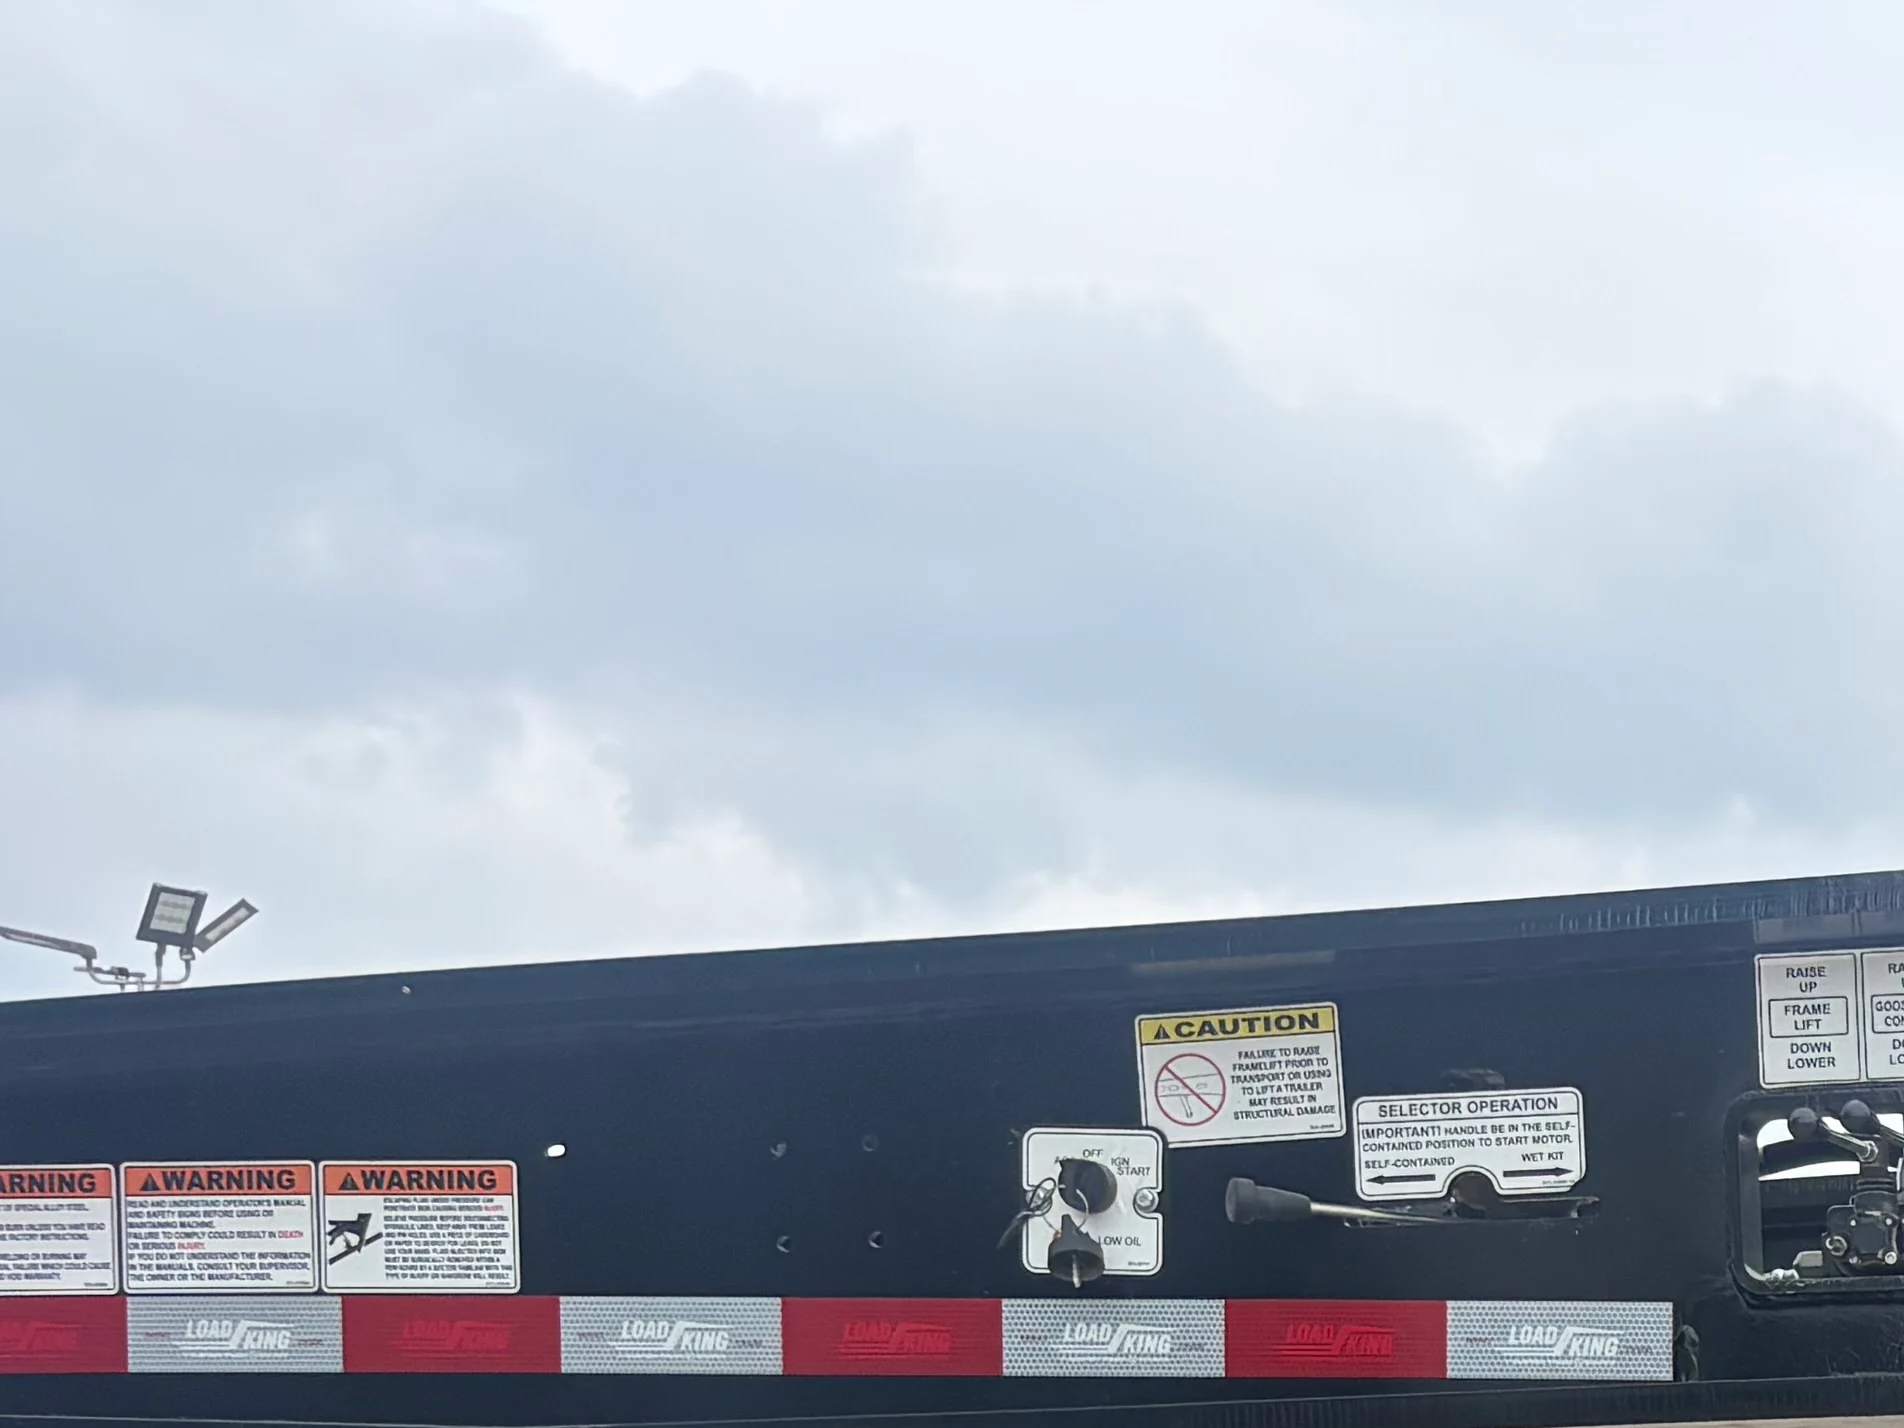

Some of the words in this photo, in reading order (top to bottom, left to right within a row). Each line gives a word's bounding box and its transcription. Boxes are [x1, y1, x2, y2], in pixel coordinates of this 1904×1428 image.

[1786, 967, 1827, 978] RAISE
[1800, 982, 1817, 993] UP
[1784, 1003, 1831, 1016] FRAME
[1174, 1013, 1319, 1037] CAUTION
[1794, 1019, 1822, 1030] LIFT
[1791, 1042, 1832, 1054] DOWN
[1787, 1057, 1836, 1069] LOWER
[1378, 1102, 1462, 1118] SELECTOR
[1468, 1097, 1558, 1113] OPERATION
[1444, 1125, 1487, 1136] HANDLE
[1491, 1125, 1504, 1133] BE
[1509, 1124, 1519, 1132] IN
[1522, 1123, 1542, 1132] THE
[1362, 1141, 1423, 1153] CONTAINED
[1425, 1139, 1475, 1149] POSITION
[1478, 1138, 1492, 1147] TO
[1495, 1136, 1528, 1146] START
[1083, 1149, 1103, 1157] OFF
[1521, 1153, 1544, 1162] WET
[1548, 1152, 1564, 1161] KIT
[1111, 1158, 1130, 1166] IGN
[1364, 1157, 1455, 1169] SELF-CONTAINED
[1117, 1167, 1151, 1176] START
[0, 1173, 97, 1194] ARNING
[162, 1170, 296, 1190] WARNING
[361, 1170, 496, 1190] WARNING
[1099, 1236, 1122, 1246] LOW
[1125, 1237, 1141, 1246] OIL
[185, 1320, 233, 1338] LOAD
[244, 1330, 291, 1349] KING
[621, 1321, 670, 1339] LOAD
[680, 1331, 729, 1351] KING
[1063, 1323, 1112, 1341] LOAD
[1123, 1334, 1171, 1353] KING
[1508, 1326, 1557, 1345] LOAD
[1568, 1337, 1619, 1356] KING
